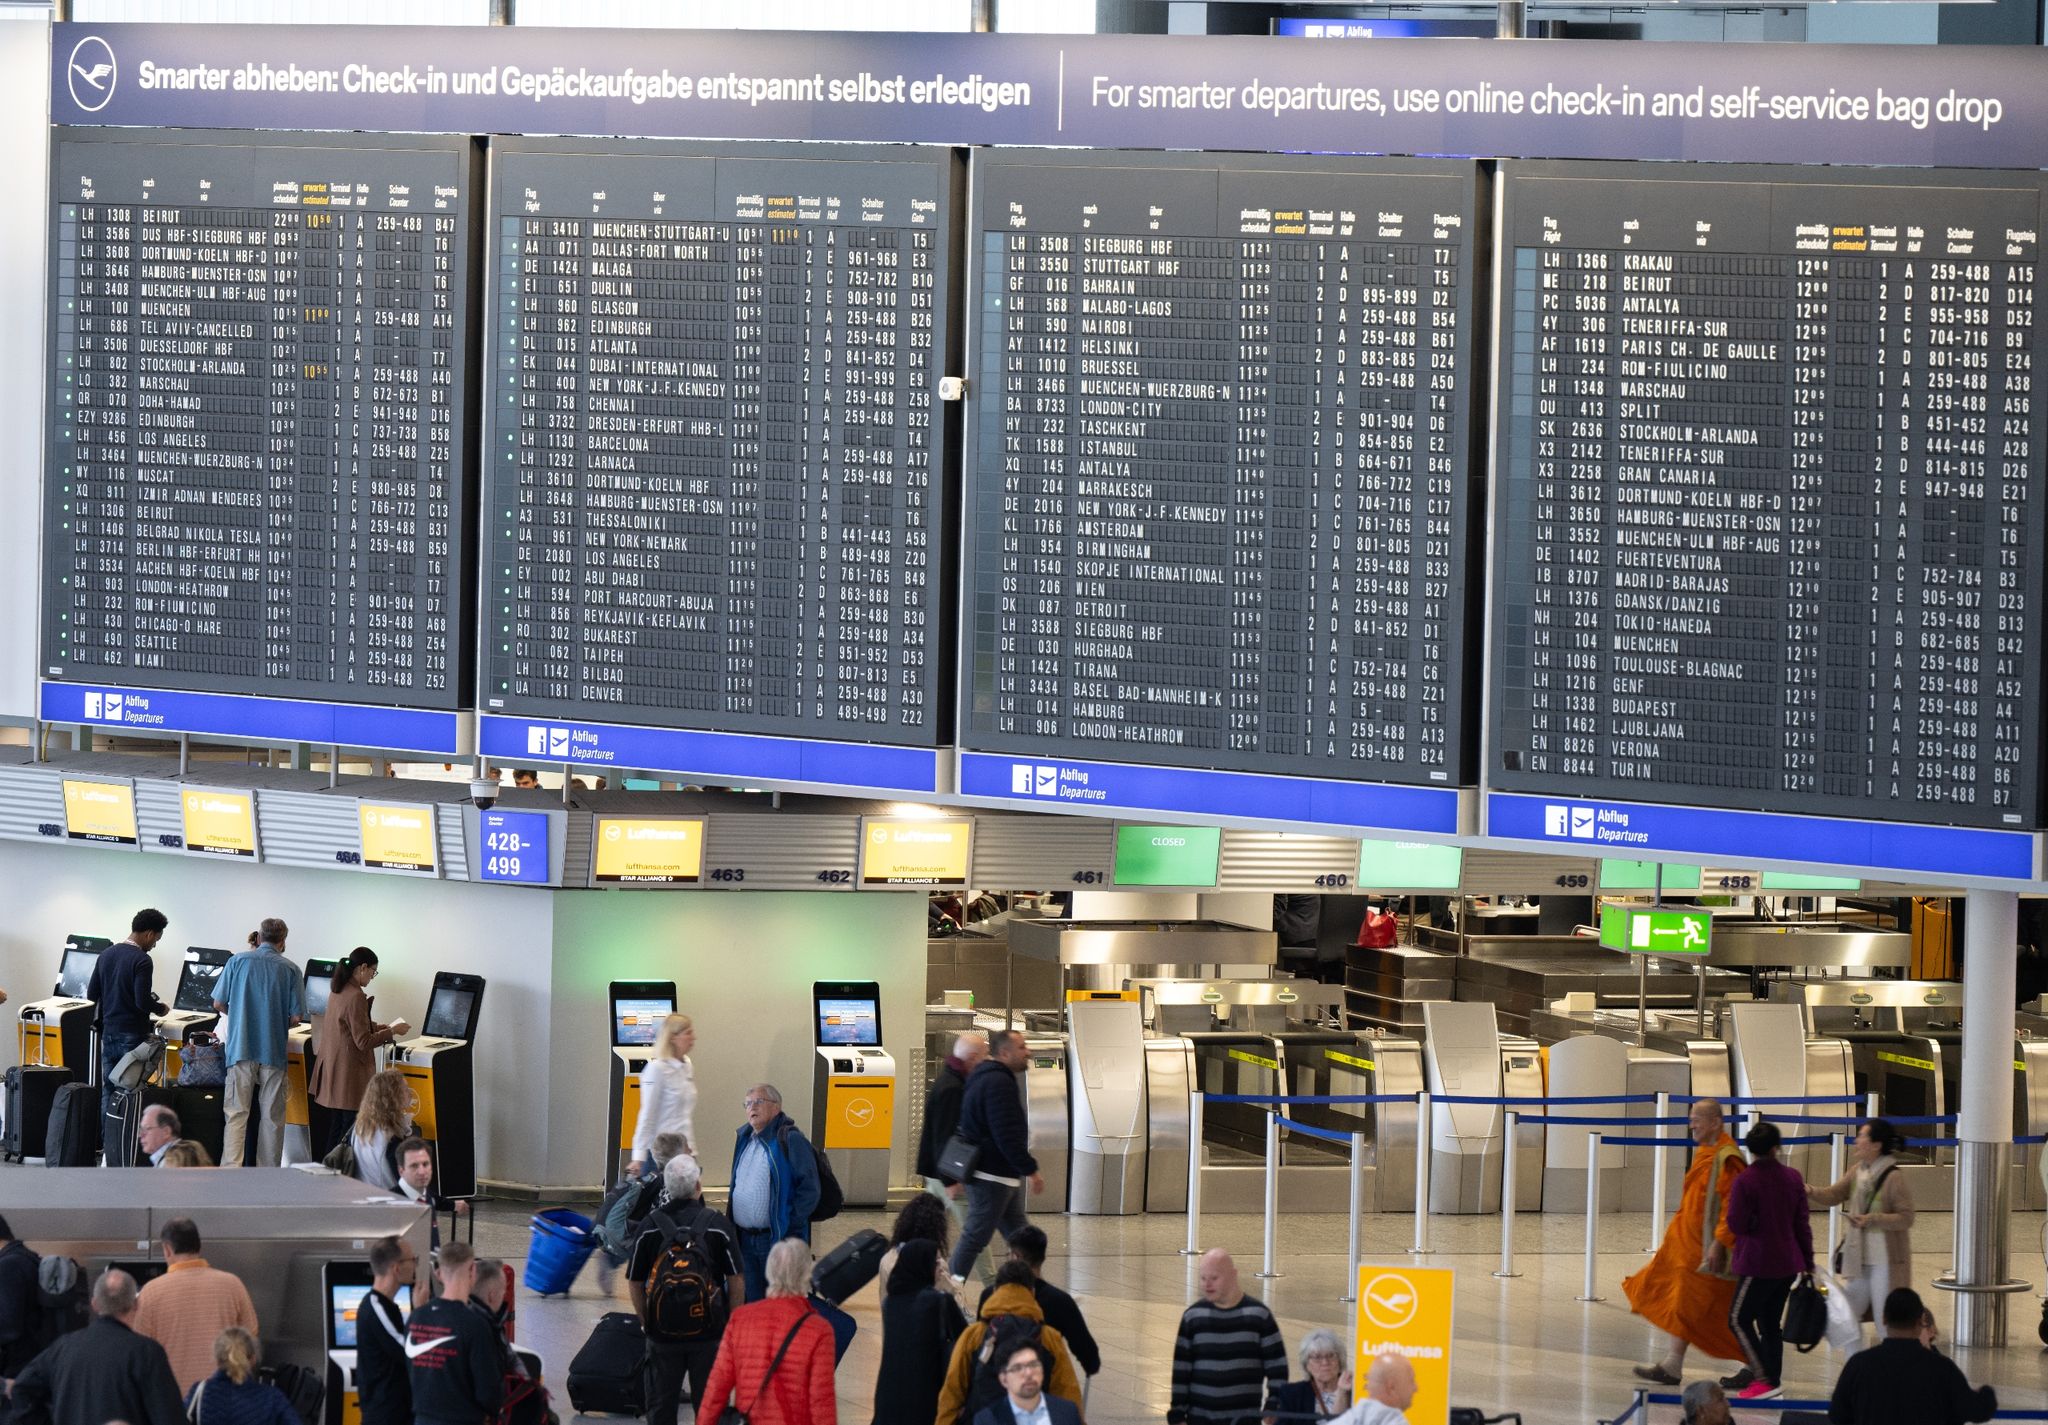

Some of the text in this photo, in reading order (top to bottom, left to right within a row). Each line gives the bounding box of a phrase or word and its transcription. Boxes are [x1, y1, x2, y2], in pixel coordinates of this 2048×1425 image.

[1347, 25, 1372, 38] Abflug
[139, 60, 1030, 112] Smarter abheben: Check-in und Gepäckaufgabe entspannt selbst erledigen
[1092, 76, 2003, 130] For smarter departures, use online check-in and self-service bag drop
[83, 208, 454, 231] LH 1308 BEIRUT 259-488 B47
[526, 259, 932, 287] DE 1424 MALAGA 752-782 B10
[1545, 253, 2033, 282] LH 1366 KRAKAU 259-488 A15
[526, 279, 931, 307] EI 651 DUBLIN 908-910 D51
[1010, 277, 1447, 305] GF 016 BAHRAIN 895-899 D2
[81, 300, 451, 326] LH 100 MUENCHEN 259-488 A14
[1010, 317, 1453, 347] LH 590 NAIROBI 259-488 B61
[1543, 316, 2022, 347] 4Y 306 TENERIFFA-SUR 704-716 B9
[524, 355, 717, 377] EK 044 DUBAI-INTERNATIONAL
[80, 374, 188, 390] LO 382 WARSCHAU
[1008, 397, 1161, 416] BA 8733 LONDON-CITY
[79, 410, 194, 428] EZY 9286 EDINBURGH
[522, 432, 648, 451] LH 1130 BARCELONA
[1541, 421, 1757, 445] SK 2636 STOCKHOLM-ARLANDA
[77, 502, 172, 519] LH 1306 BEIRUT
[1005, 537, 1150, 558] LH 954 BIRMINGHAM
[75, 575, 228, 597] BA 903 LONDON-HEATHROW
[1538, 568, 1728, 593] IB 8707 MADRID-BARAJAS
[1003, 597, 1125, 617] DK 087 DETROIT
[74, 630, 176, 649] LH 490 SEATTLE
[518, 624, 637, 644] RO 302 BUKAREST
[1535, 631, 1678, 653] LH 104 MUENCHEN
[1002, 658, 1117, 678] LH 1424 TIRANA
[516, 681, 622, 701] UA 181 DENVER
[125, 695, 149, 709] Abflug
[1534, 694, 1675, 716] LH 1338 BUDAPEST
[125, 711, 164, 724] Departures
[572, 730, 598, 745] Abflug
[571, 746, 614, 760] Departures
[1060, 768, 1088, 784] Abflug
[1532, 756, 2009, 804] EN 8844 TURIN 259-488 B7
[1060, 785, 1106, 800] Departures
[1597, 809, 1629, 826] Abflug
[487, 832, 531, 851] 428-
[627, 827, 687, 840] Lufthansa
[1152, 837, 1186, 847] CLOSED
[1597, 826, 1648, 843] Departures
[487, 856, 520, 875] 499
[626, 862, 680, 871] lufthansa.com
[711, 869, 744, 882] 463
[818, 870, 850, 883] 462
[1073, 871, 1103, 884] 461
[1315, 874, 1347, 887] 460
[1556, 875, 1588, 888] 459
[1720, 875, 1751, 889] 458
[1363, 1340, 1443, 1358] Lufthansa
